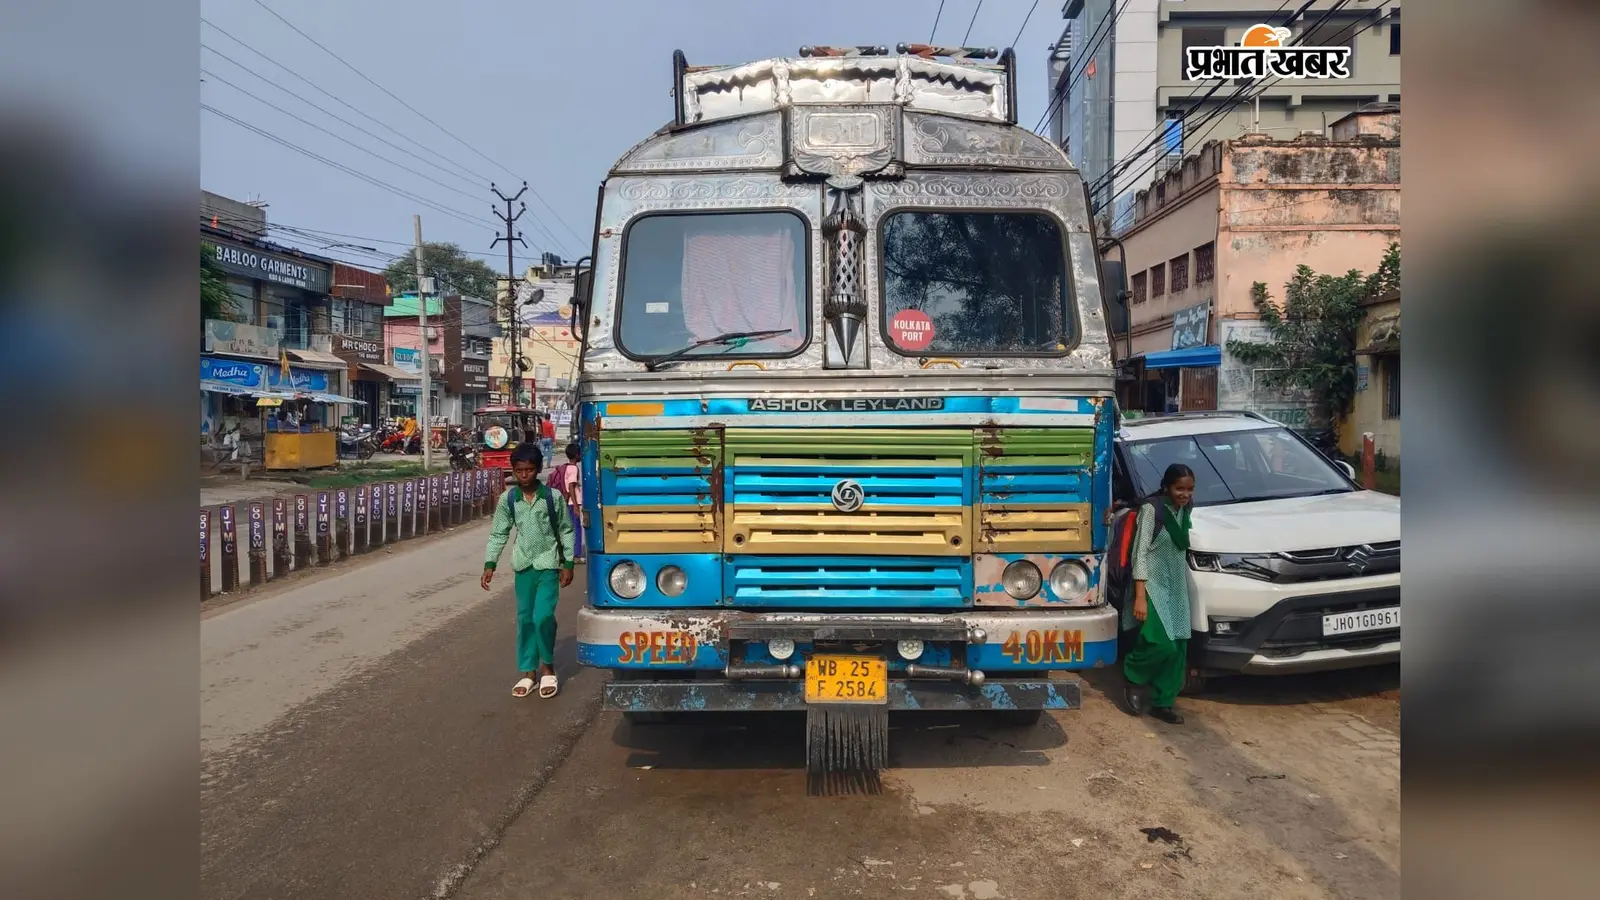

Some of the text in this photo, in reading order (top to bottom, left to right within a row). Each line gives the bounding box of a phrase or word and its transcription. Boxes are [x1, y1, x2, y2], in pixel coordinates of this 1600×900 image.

[216, 245, 308, 280] BABLOO GARMENTS
[894, 319, 931, 331] KOLKATA
[901, 331, 924, 342] PORT
[212, 366, 248, 378] Medha
[750, 397, 944, 411] ASHOK LEYLAND
[338, 491, 346, 503] GO
[404, 481, 412, 512] GO SLOW
[418, 479, 426, 509] JTMC
[432, 477, 438, 487] GO
[452, 473, 460, 501] JTMC
[297, 498, 305, 510] GO
[319, 494, 328, 531] JTMC
[357, 488, 365, 523] JTMC
[372, 486, 380, 520] GO SLOW
[388, 484, 396, 516] GO SLOW
[223, 509, 233, 553] JTMC
[252, 506, 262, 548] GO SLOW
[275, 502, 285, 541] JTMC
[1333, 611, 1399, 631] JH01GD961
[617, 631, 698, 665] SPEED
[1001, 629, 1085, 665] 40KM
[817, 659, 870, 677] WB 25
[817, 680, 876, 697] F 2584
